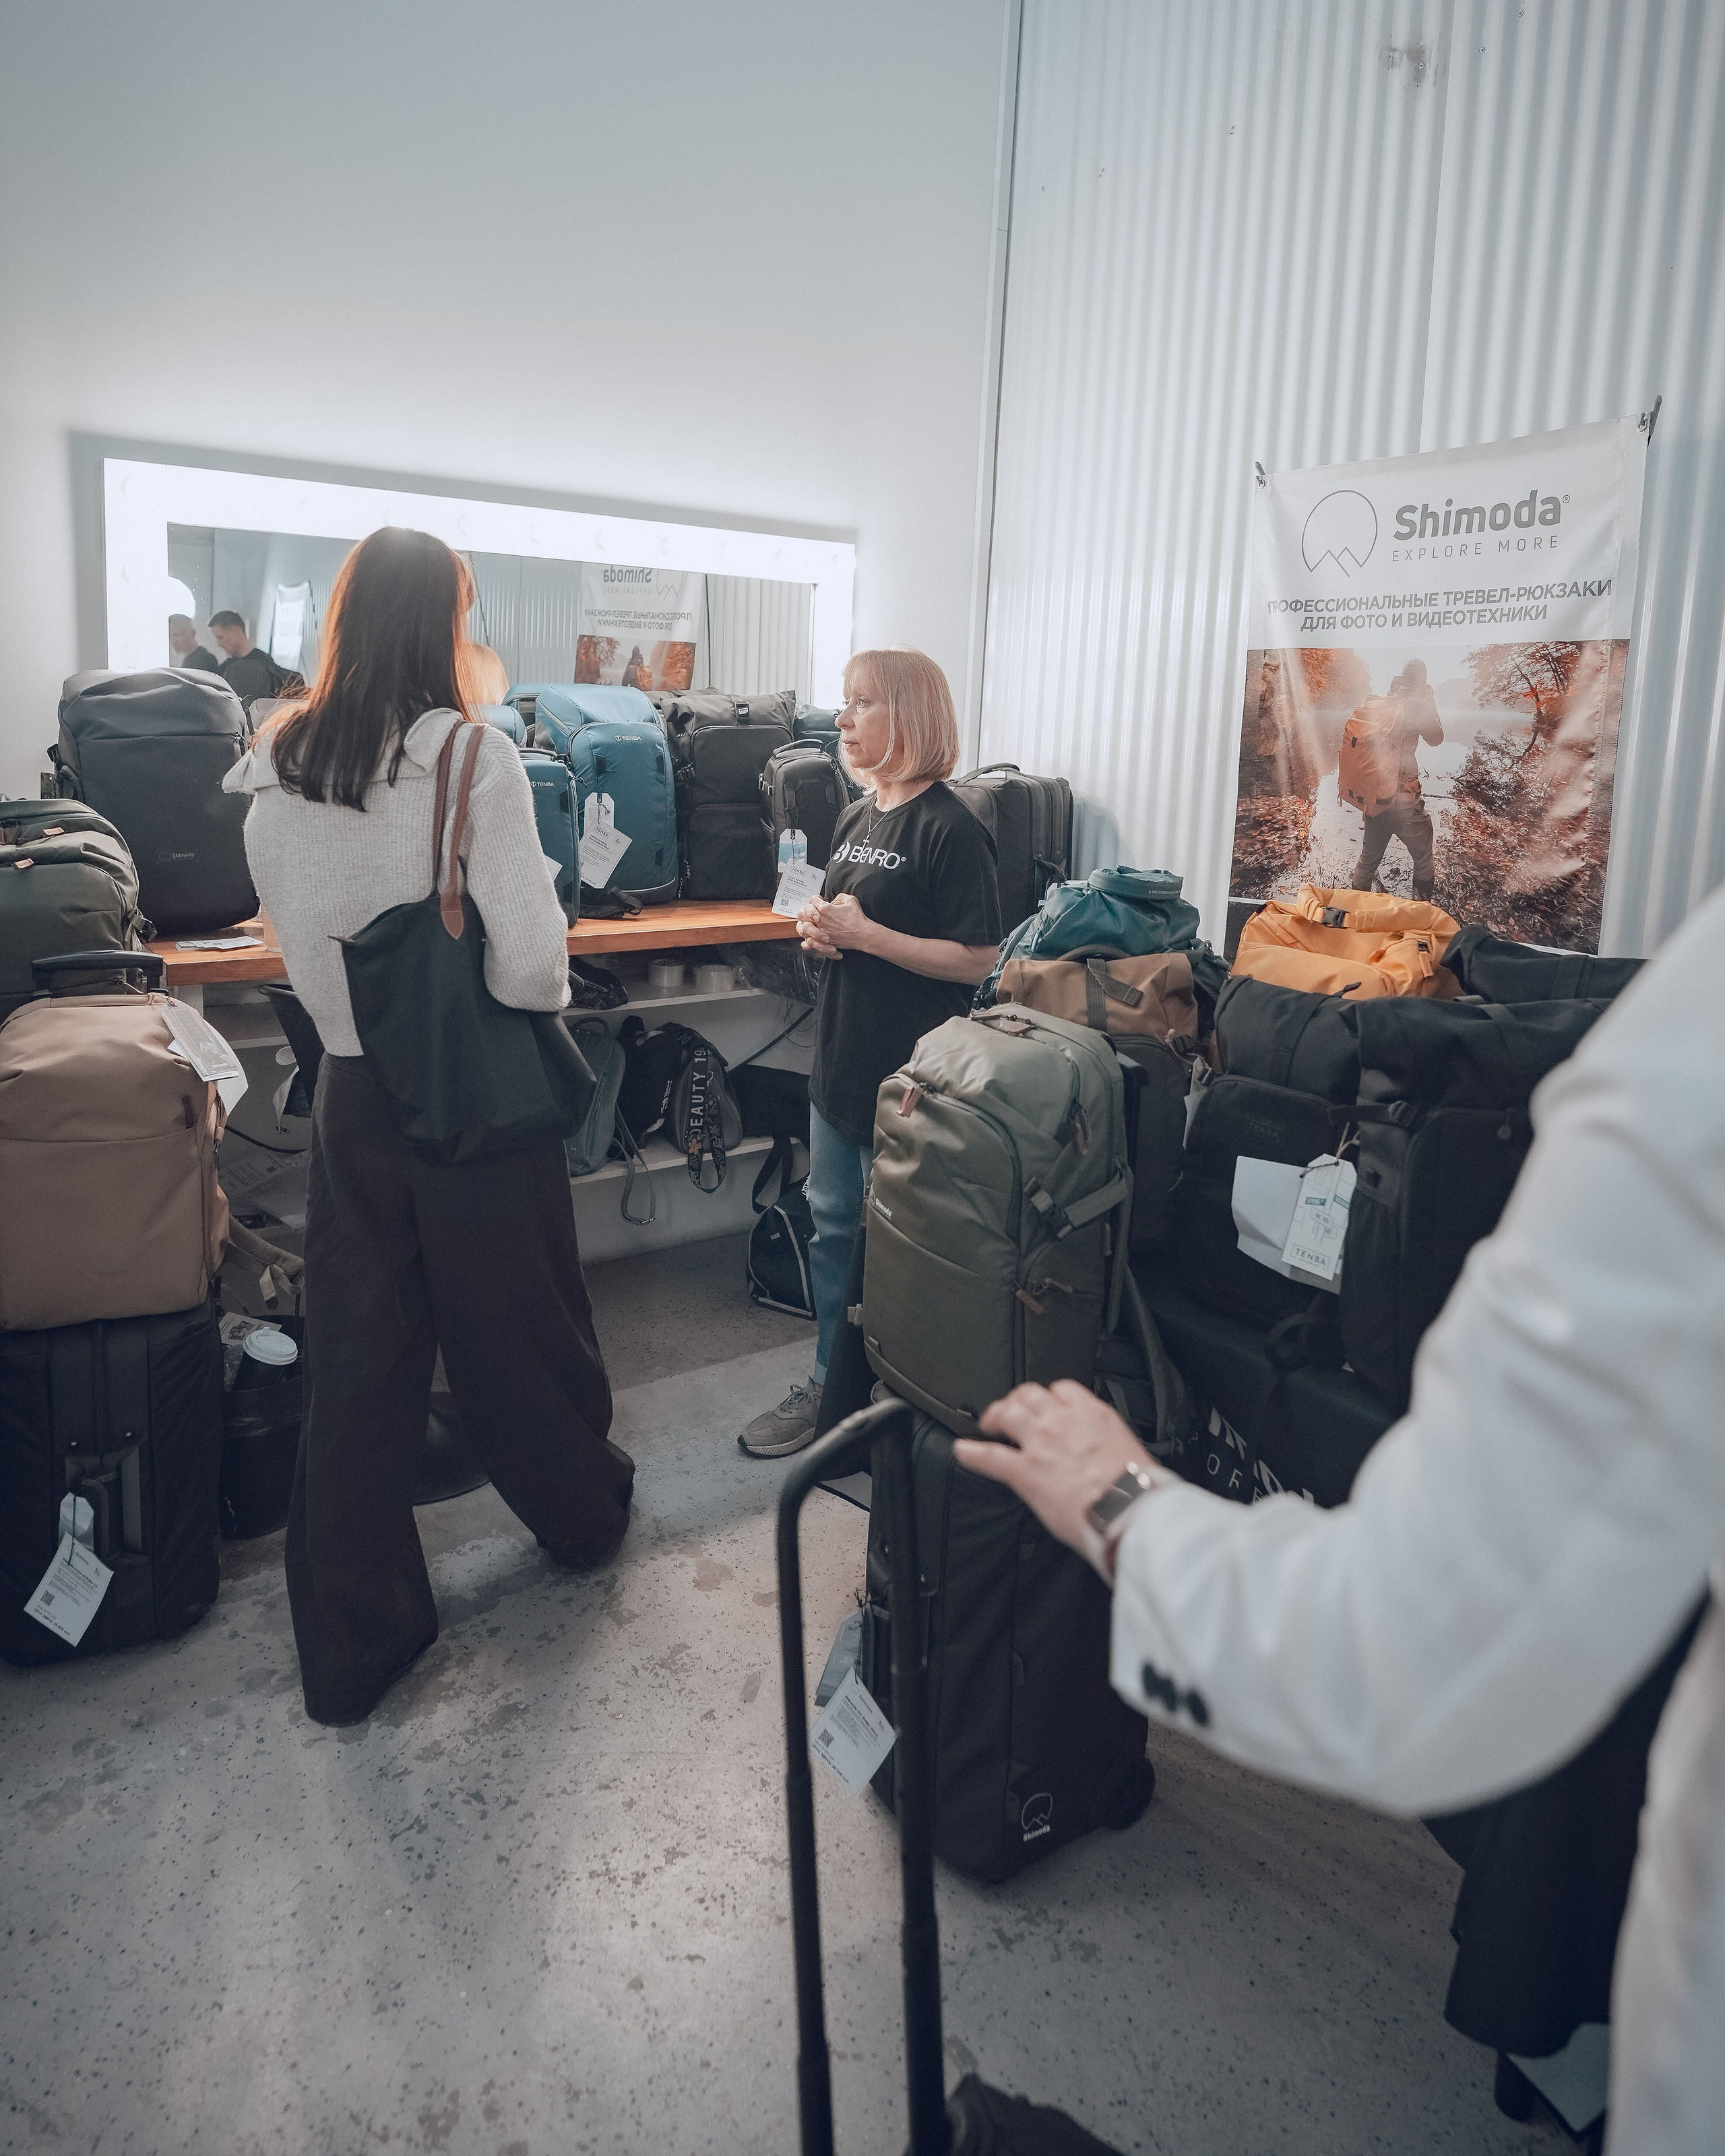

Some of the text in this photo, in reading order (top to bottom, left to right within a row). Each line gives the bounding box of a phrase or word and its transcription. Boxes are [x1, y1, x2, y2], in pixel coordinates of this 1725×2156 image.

[1392, 535, 1558, 562] EXPLORE MORE
[1267, 579, 1612, 614] ПРОФЕССИОНАЛЬНЫЕ ТРЕВЕЛ-РЮКЗАКИ
[1300, 604, 1548, 632] ДЛЯ ФОТО И ВИДЕОТЕХНИКИ
[1296, 1248, 1326, 1265] TENBA
